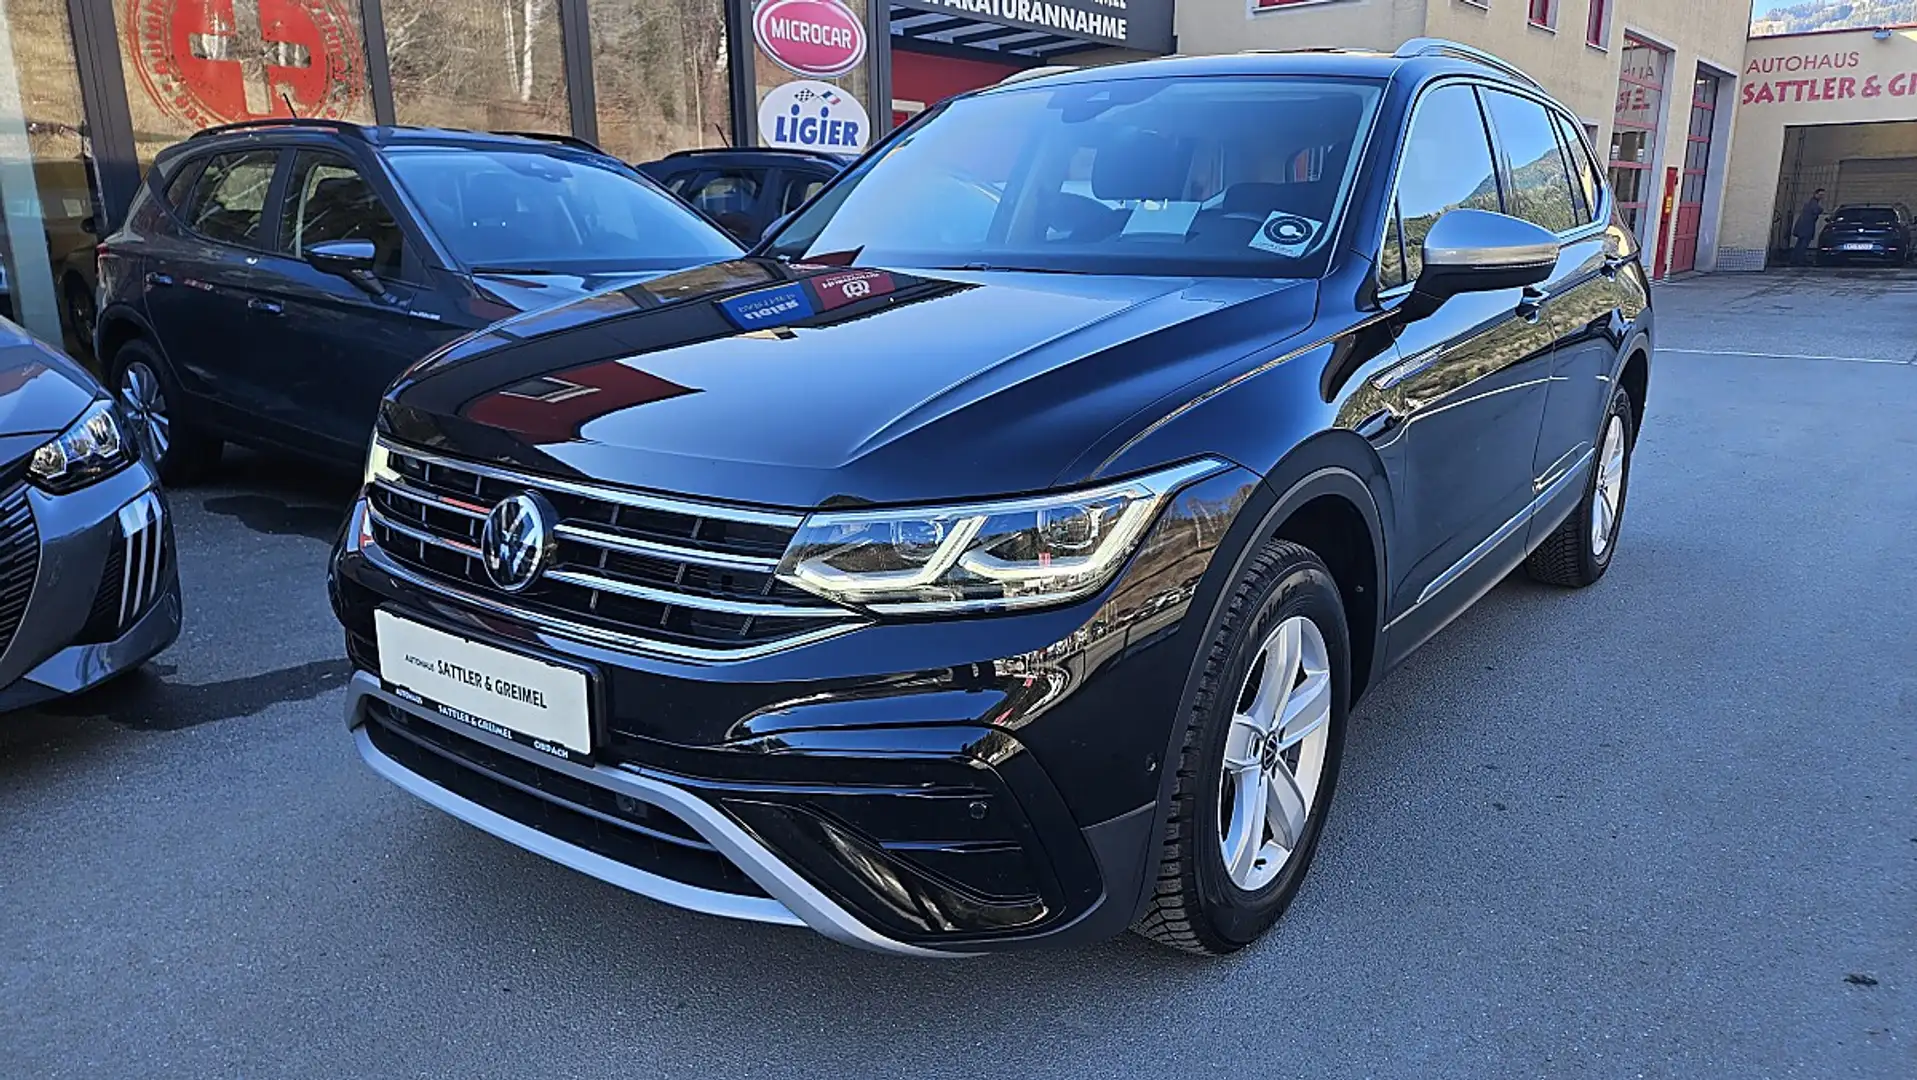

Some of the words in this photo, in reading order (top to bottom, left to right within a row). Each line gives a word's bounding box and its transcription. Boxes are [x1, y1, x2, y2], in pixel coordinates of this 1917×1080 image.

[770, 16, 852, 49] MICROCAR
[920, 0, 1127, 40] RATURANNAHME
[1746, 51, 1860, 75] AUTOHAUS
[1742, 76, 1856, 105] SATTLER
[1861, 74, 1882, 98] &
[437, 659, 482, 688] SATTLER
[484, 675, 493, 692] &
[494, 679, 548, 709] GREIMEL
